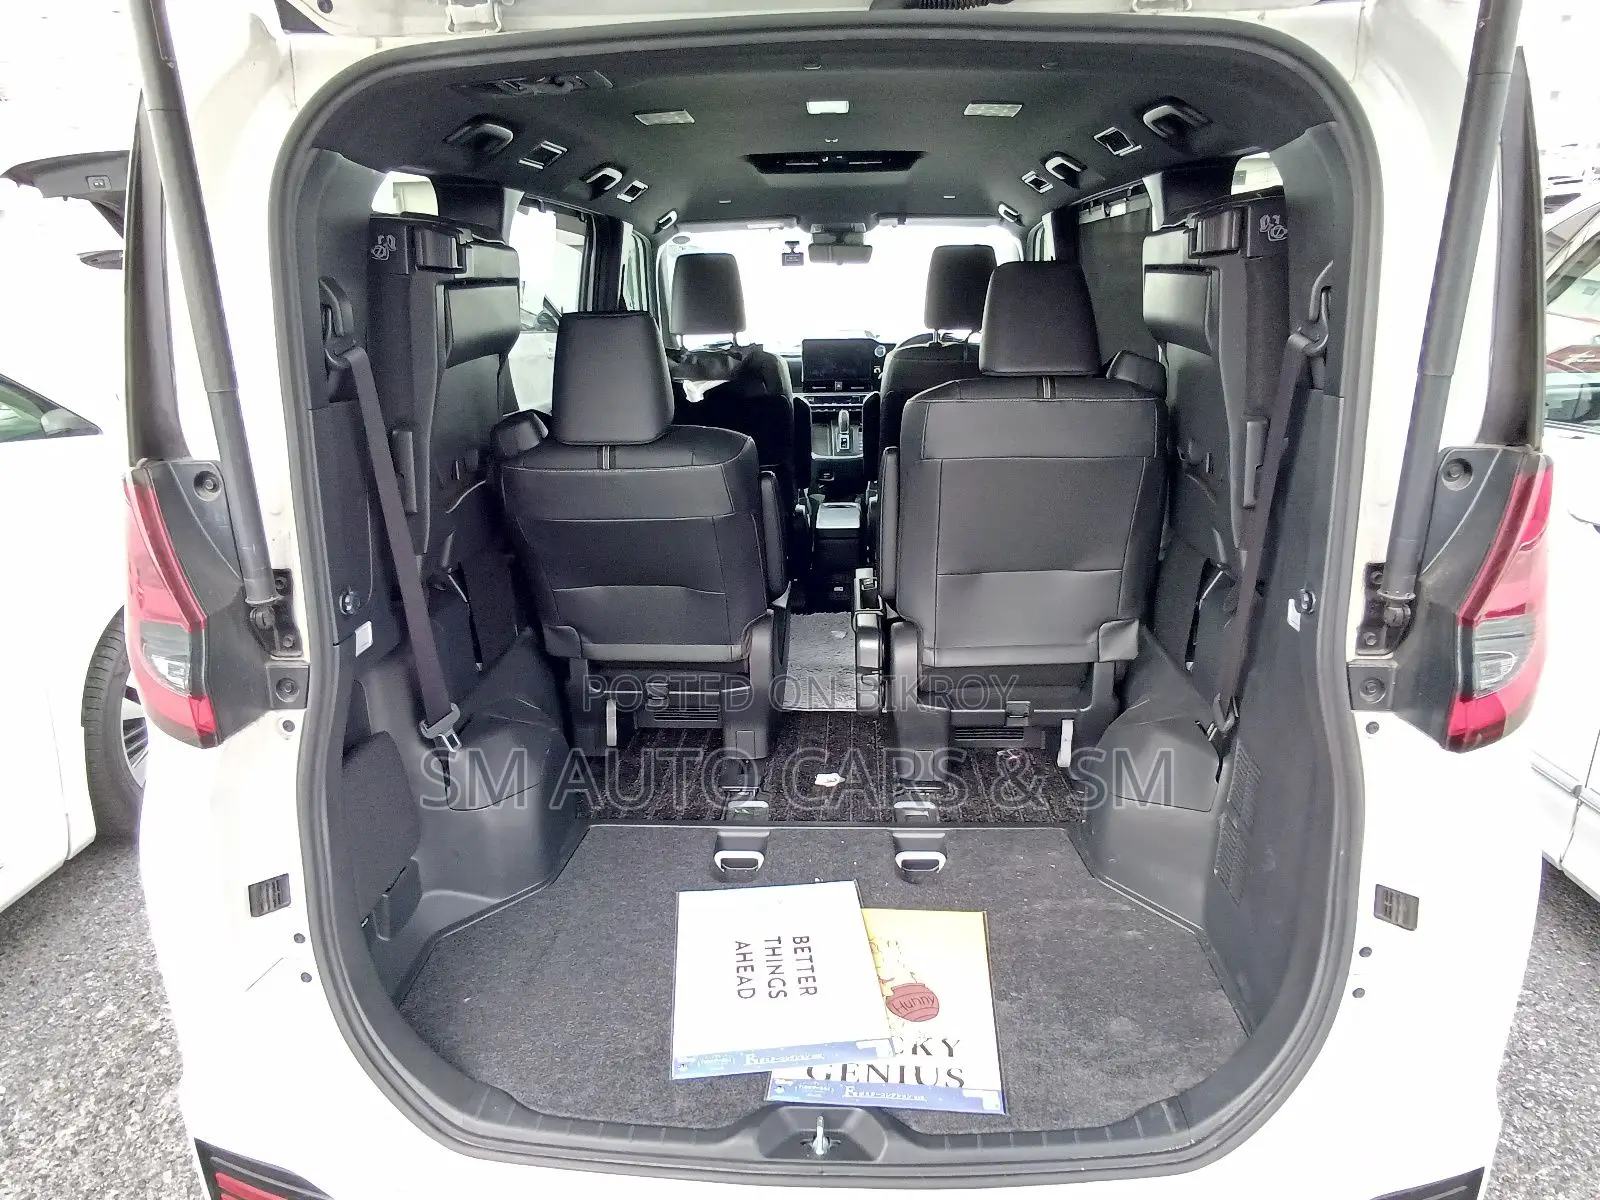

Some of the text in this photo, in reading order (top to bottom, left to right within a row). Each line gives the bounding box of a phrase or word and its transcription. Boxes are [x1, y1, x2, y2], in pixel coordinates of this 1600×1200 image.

[735, 940, 756, 1000] AHEAD
[763, 935, 788, 999] THINGS
[792, 935, 818, 997] BETTER
[891, 995, 936, 1015] Hunny
[889, 1036, 961, 1058] CKY
